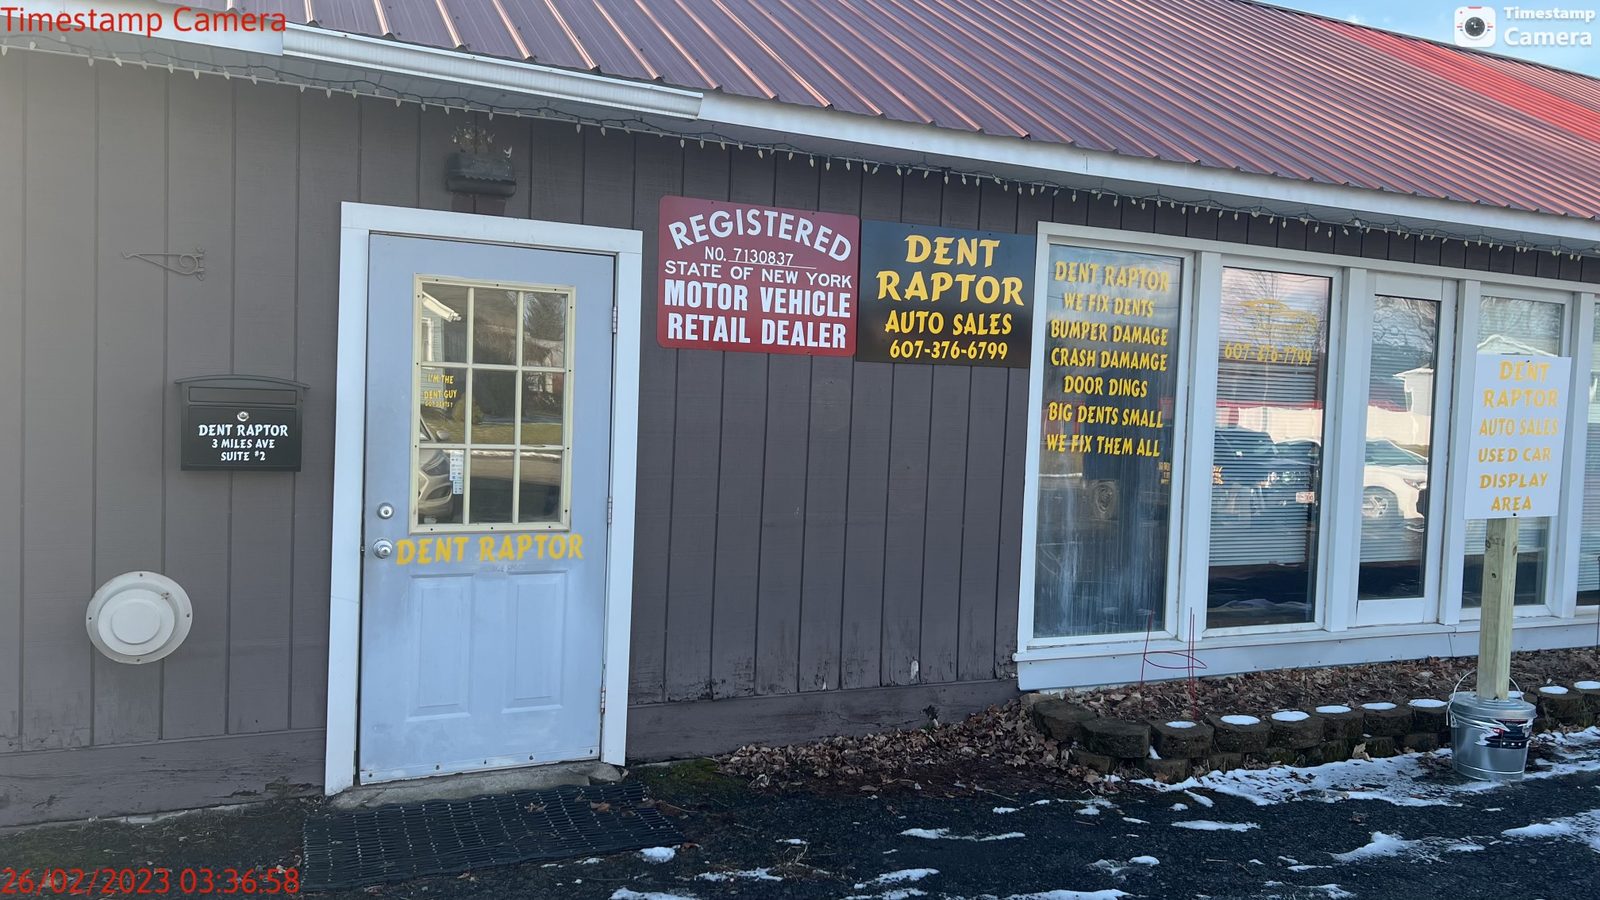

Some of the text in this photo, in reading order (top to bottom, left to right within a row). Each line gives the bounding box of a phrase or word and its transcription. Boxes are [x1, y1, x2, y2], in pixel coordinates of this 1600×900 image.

[668, 208, 852, 261] REGISTERED
[704, 246, 794, 267] NO. 7130837
[904, 234, 1000, 268] DENT
[665, 260, 852, 288] STATE OF NEW YORK
[1055, 261, 1169, 292] DENT RAPTOR
[664, 279, 851, 318] MOTOR VEHICLE
[876, 270, 1025, 306] RAPTOR
[1063, 292, 1155, 318] WE FIX DENTS
[668, 313, 846, 349] RETAIL DEALER
[884, 309, 1012, 336] AUTO SALES
[1050, 319, 1169, 346] BUMPER DAMAGE
[889, 339, 1008, 360] 607-376-6799
[1051, 347, 1168, 371] CRASH DAMAMGE
[441, 374, 454, 384] THE
[1499, 360, 1550, 384] DENT
[443, 389, 458, 399] GUY
[1064, 375, 1148, 398] DOOR DINGS
[1483, 388, 1559, 409] RAPTOR
[1048, 402, 1164, 428] BIG DENTS SMALL
[1479, 417, 1559, 437] AUTO SALES
[198, 424, 289, 437] DENT RAPTOR
[211, 439, 276, 449] 3 MILES AVE
[220, 450, 266, 461] SUITE #2
[1047, 433, 1160, 457] WE FIX THEM ALL
[1478, 447, 1552, 463] USED CAR
[1480, 473, 1549, 489] DISPLAY
[1491, 495, 1533, 511] AREA
[395, 533, 585, 566] DENT RAPTOR
